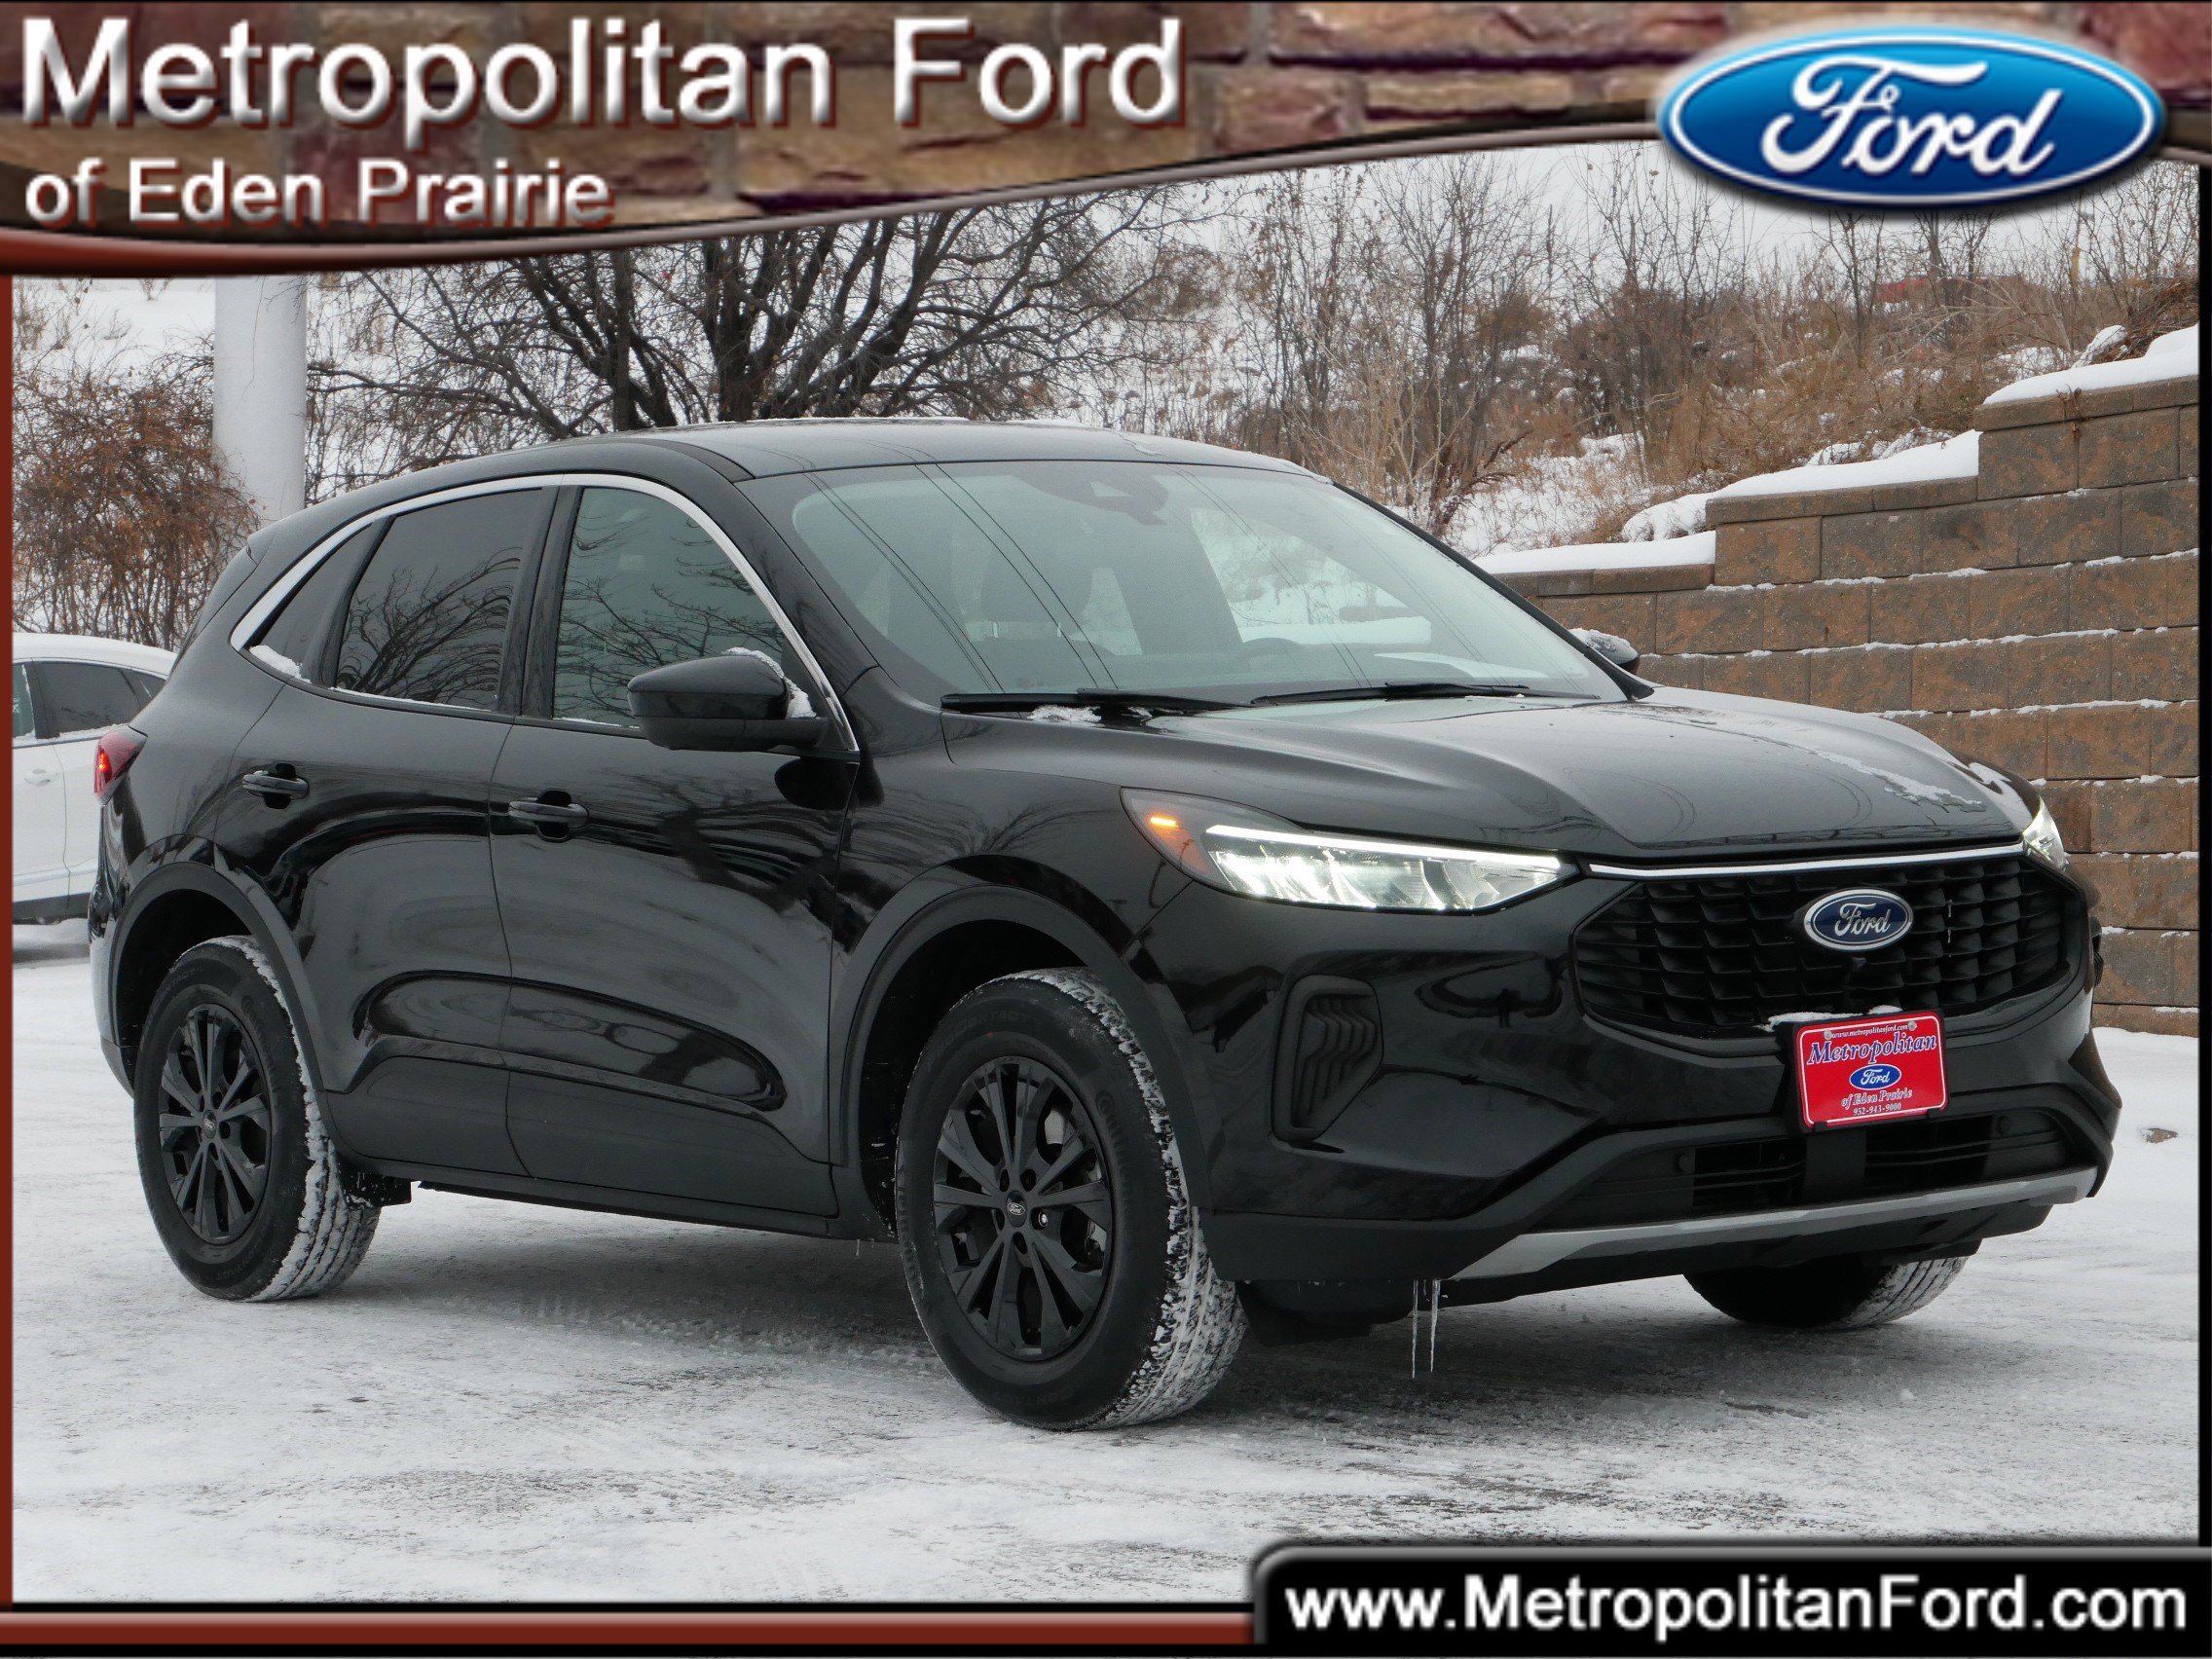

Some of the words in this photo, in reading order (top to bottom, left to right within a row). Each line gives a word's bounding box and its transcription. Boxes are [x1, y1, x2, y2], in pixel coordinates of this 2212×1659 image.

[1834, 902, 1892, 937] Ford
[1830, 1024, 1908, 1040] www.metropolitanford.com
[1807, 1031, 1937, 1064] Metropolitan
[1860, 1068, 1891, 1086] Ford
[1841, 1093, 1854, 1110] of
[1853, 1091, 1878, 1106] Eden
[1879, 1088, 1913, 1102] Prairie
[1853, 1102, 1902, 1116] 952-943-9000
